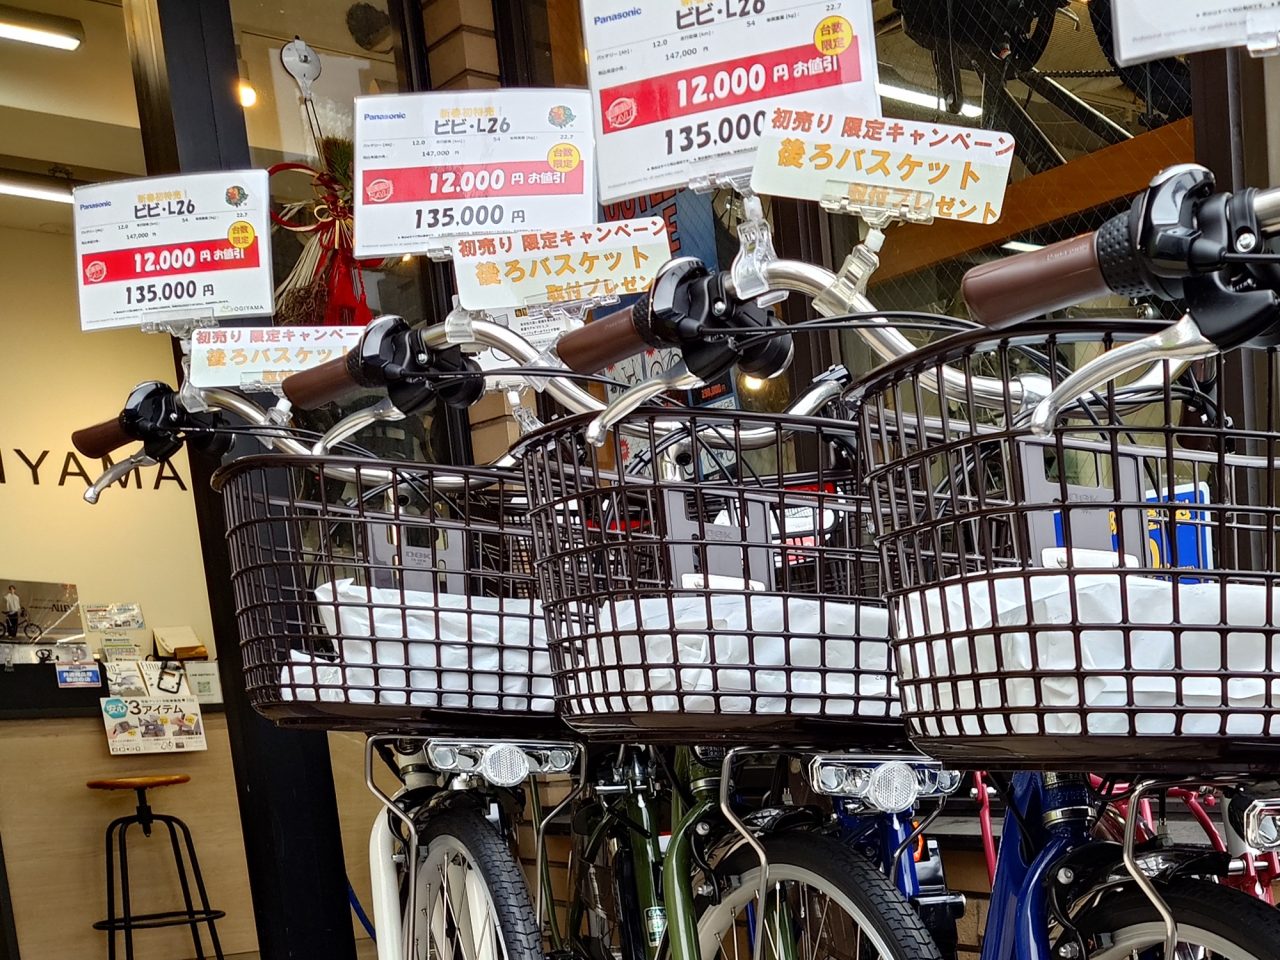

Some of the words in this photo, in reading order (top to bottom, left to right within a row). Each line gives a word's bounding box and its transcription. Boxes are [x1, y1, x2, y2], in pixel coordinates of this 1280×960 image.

[594, 6, 642, 26] Panasonic
[826, 3, 842, 12] 22.7
[820, 23, 844, 36] 台数
[652, 39, 668, 49] 12.0
[664, 47, 698, 61] 147,000
[821, 38, 845, 52] 限定
[676, 63, 766, 107] 12,000
[773, 61, 789, 83] 円
[793, 55, 838, 77] お値引
[364, 112, 406, 121] Panasonic
[664, 110, 766, 155] 135,000
[771, 107, 834, 135] 初売り
[841, 116, 1015, 157] 限定キャンペーン
[778, 137, 981, 191] 後ろバスケット
[429, 169, 505, 194] 12,000
[511, 172, 524, 185] 円
[528, 171, 566, 184] お値引
[80, 200, 112, 211] Panasonic
[415, 204, 505, 229] 135,000
[511, 209, 525, 223] 円
[458, 236, 513, 258] 初売り
[521, 220, 665, 252] 限定キャンペーン
[134, 247, 196, 273] 12,000
[200, 249, 212, 262] 円
[475, 245, 649, 286] 後ろバスケット
[126, 280, 196, 304] 135,000
[202, 284, 214, 297] 円
[545, 275, 655, 302] 取付プレゼン
[196, 330, 242, 345] 初売り
[250, 329, 360, 343] 限定キャンペー
